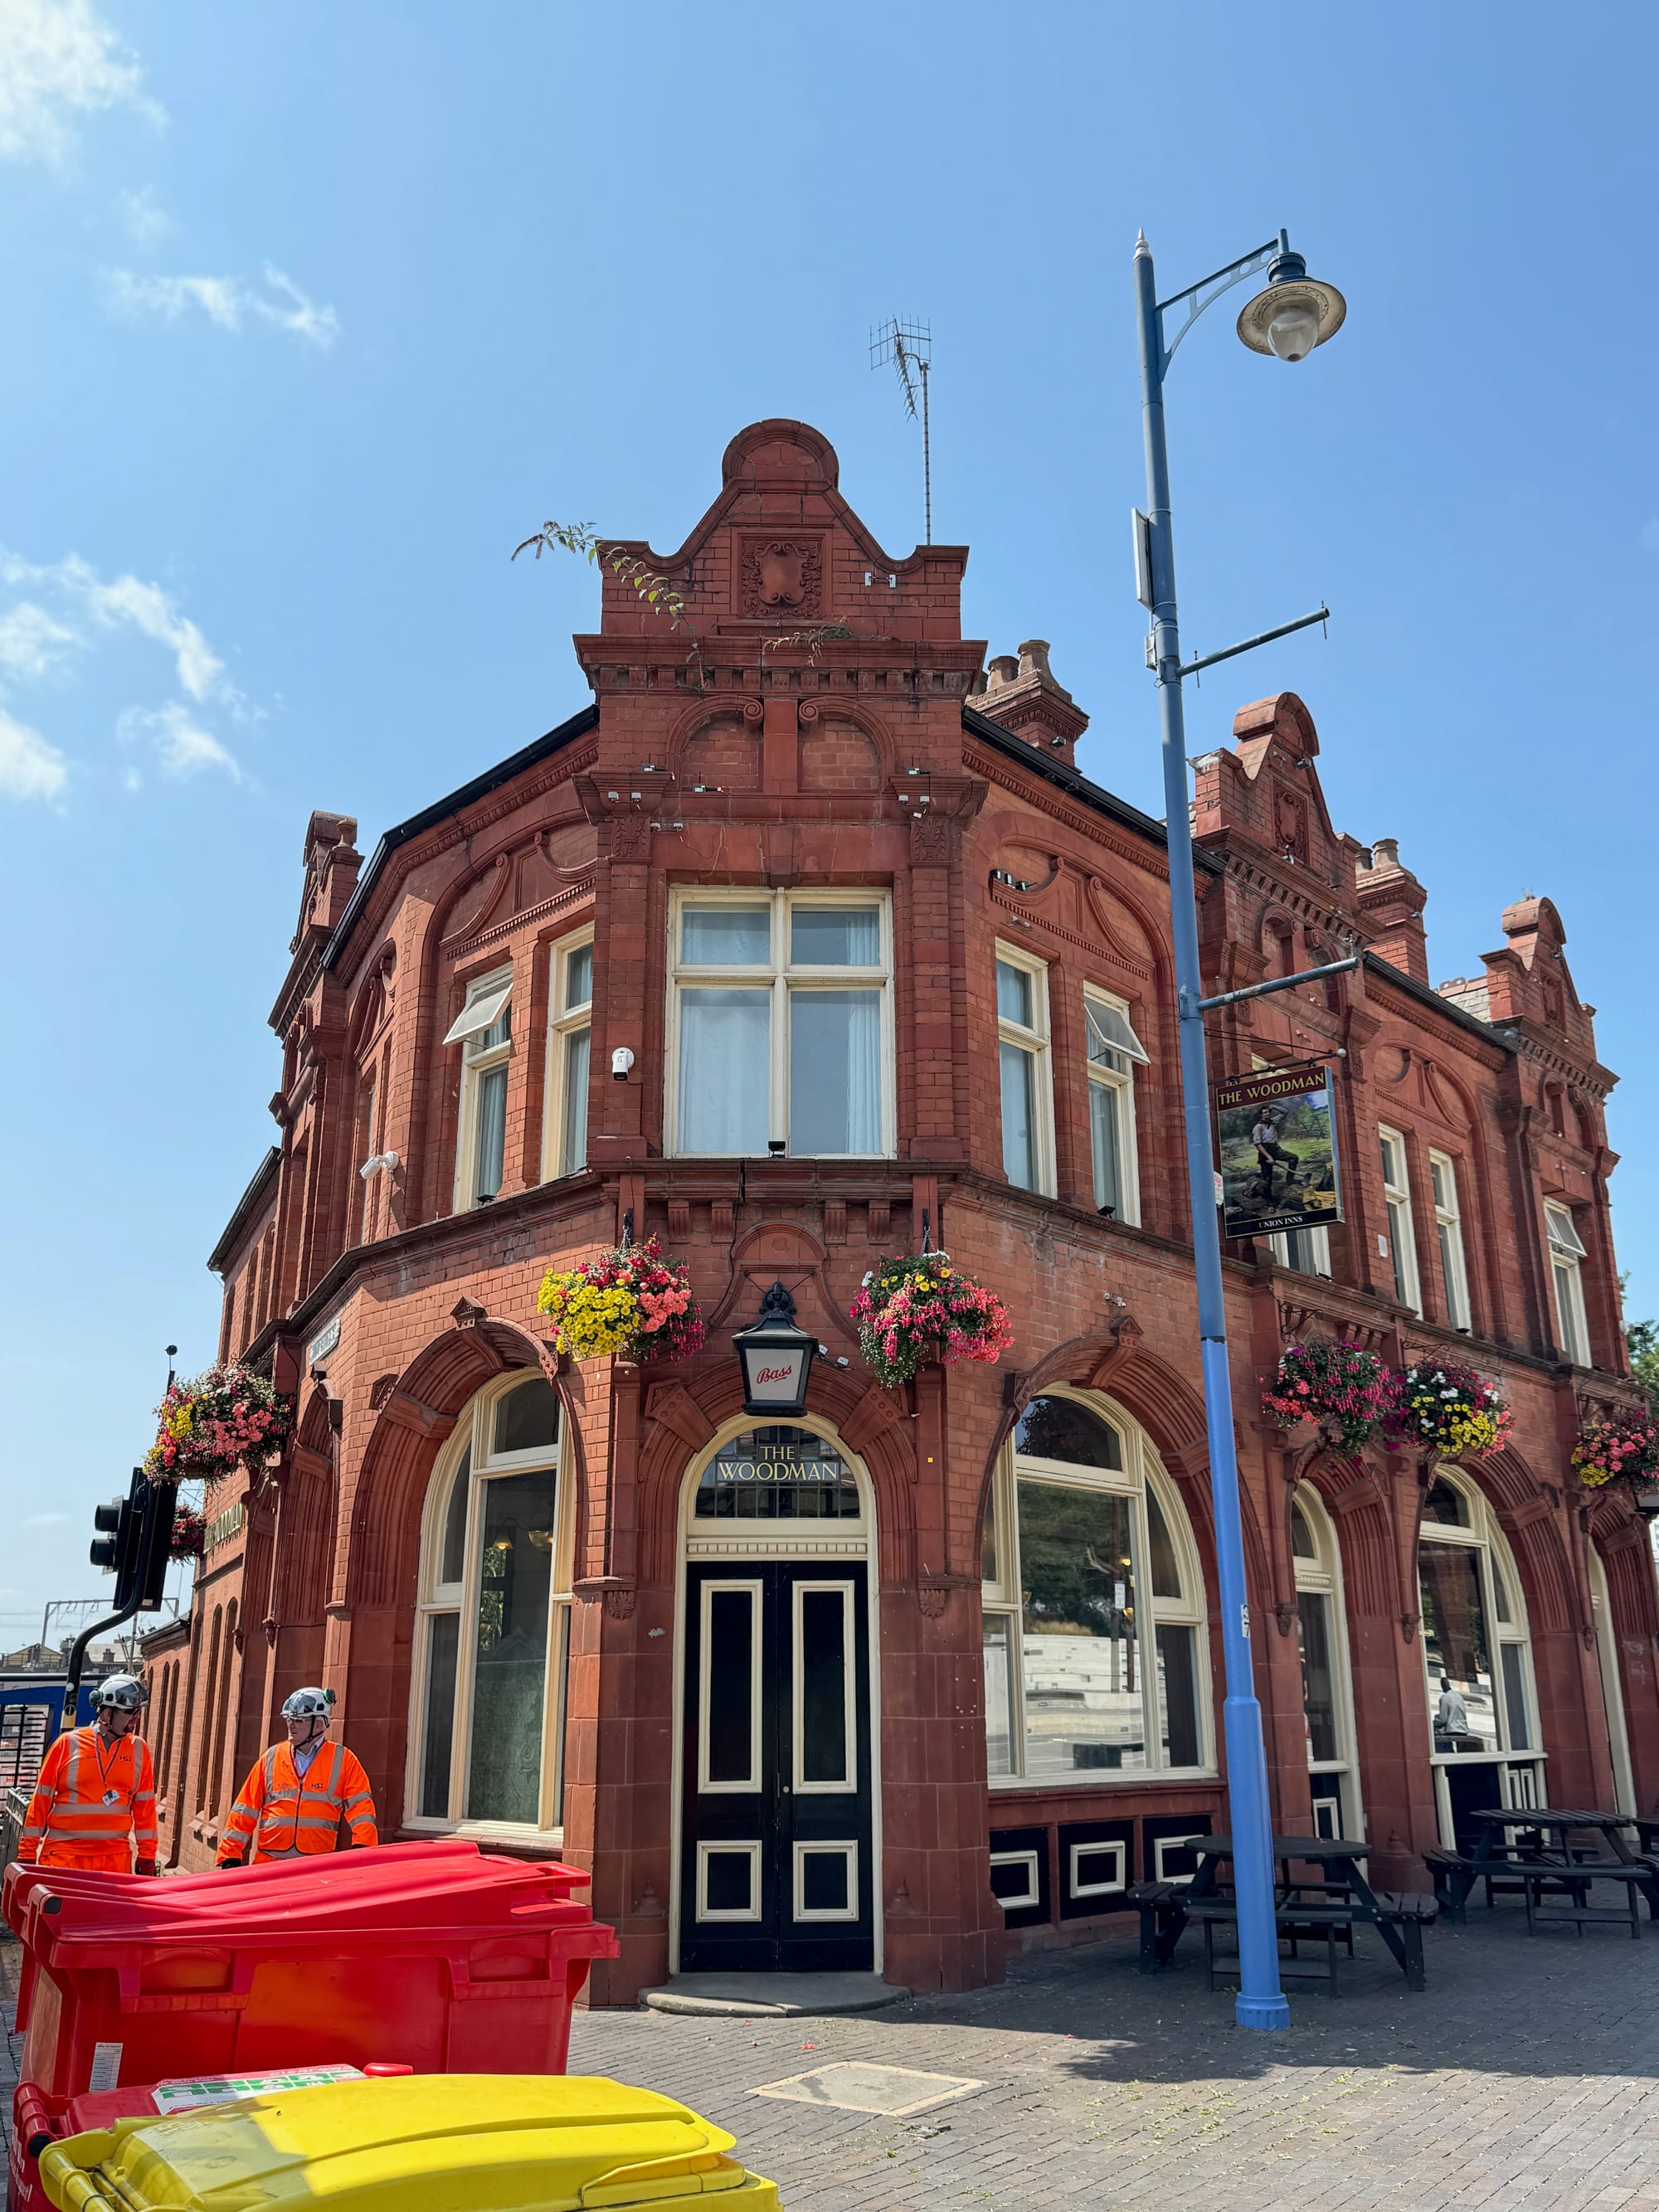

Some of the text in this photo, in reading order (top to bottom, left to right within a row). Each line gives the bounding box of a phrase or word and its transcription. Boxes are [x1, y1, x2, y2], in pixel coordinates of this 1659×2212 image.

[1218, 1072, 1325, 1106] THE WOODMAN
[1258, 1216, 1302, 1228] UNION INNS
[757, 1365, 792, 1384] Bass
[760, 1446, 795, 1461] THE
[718, 1462, 838, 1480] WOODMAN
